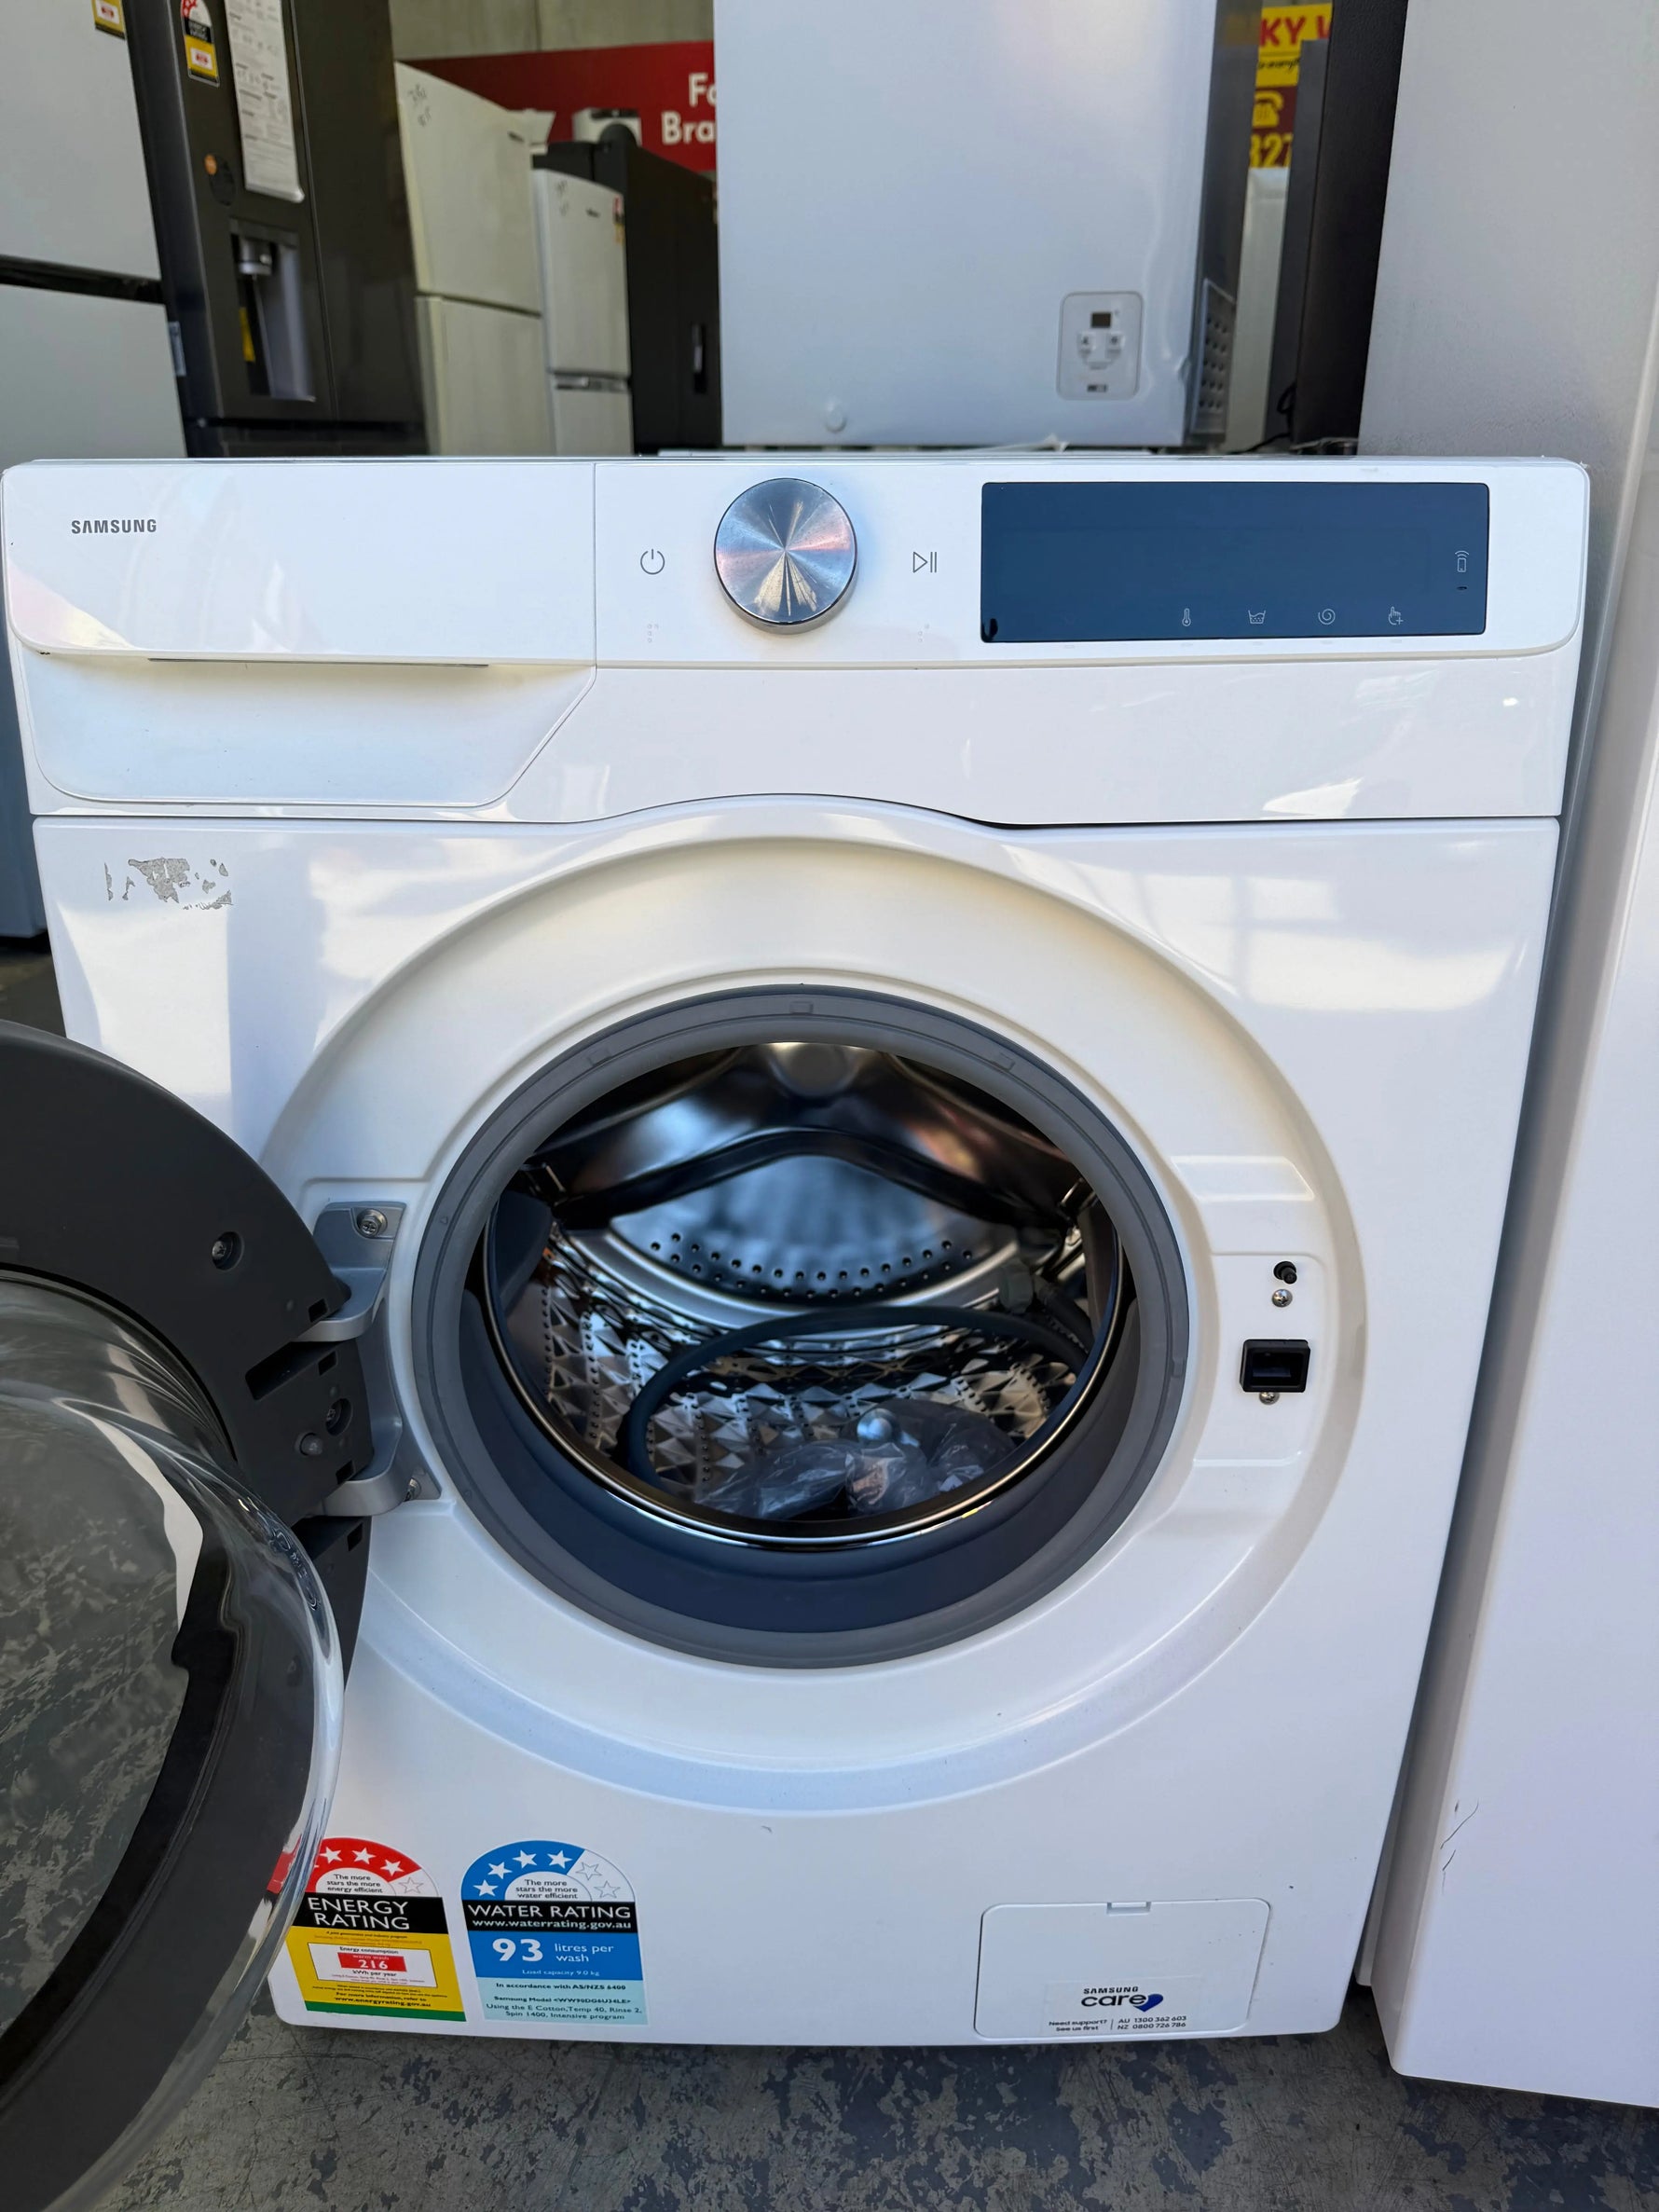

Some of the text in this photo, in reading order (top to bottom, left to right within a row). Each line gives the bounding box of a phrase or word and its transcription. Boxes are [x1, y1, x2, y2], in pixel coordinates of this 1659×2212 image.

[661, 110, 717, 145] Bra
[71, 518, 158, 534] SAMSUNG
[525, 1878, 542, 1887] The
[308, 1897, 408, 1916] ENERGY
[468, 1904, 631, 1918] WATER RATING
[314, 1912, 410, 1930] RATING
[473, 1918, 631, 1930] www.waterrating.gov.au
[492, 1938, 543, 1962] 93
[555, 1944, 614, 1953] litres per
[358, 1959, 389, 1970] 216
[556, 1954, 589, 1962] wash
[1083, 1985, 1139, 1995] SAMSUNG
[1081, 1993, 1147, 2007] care
